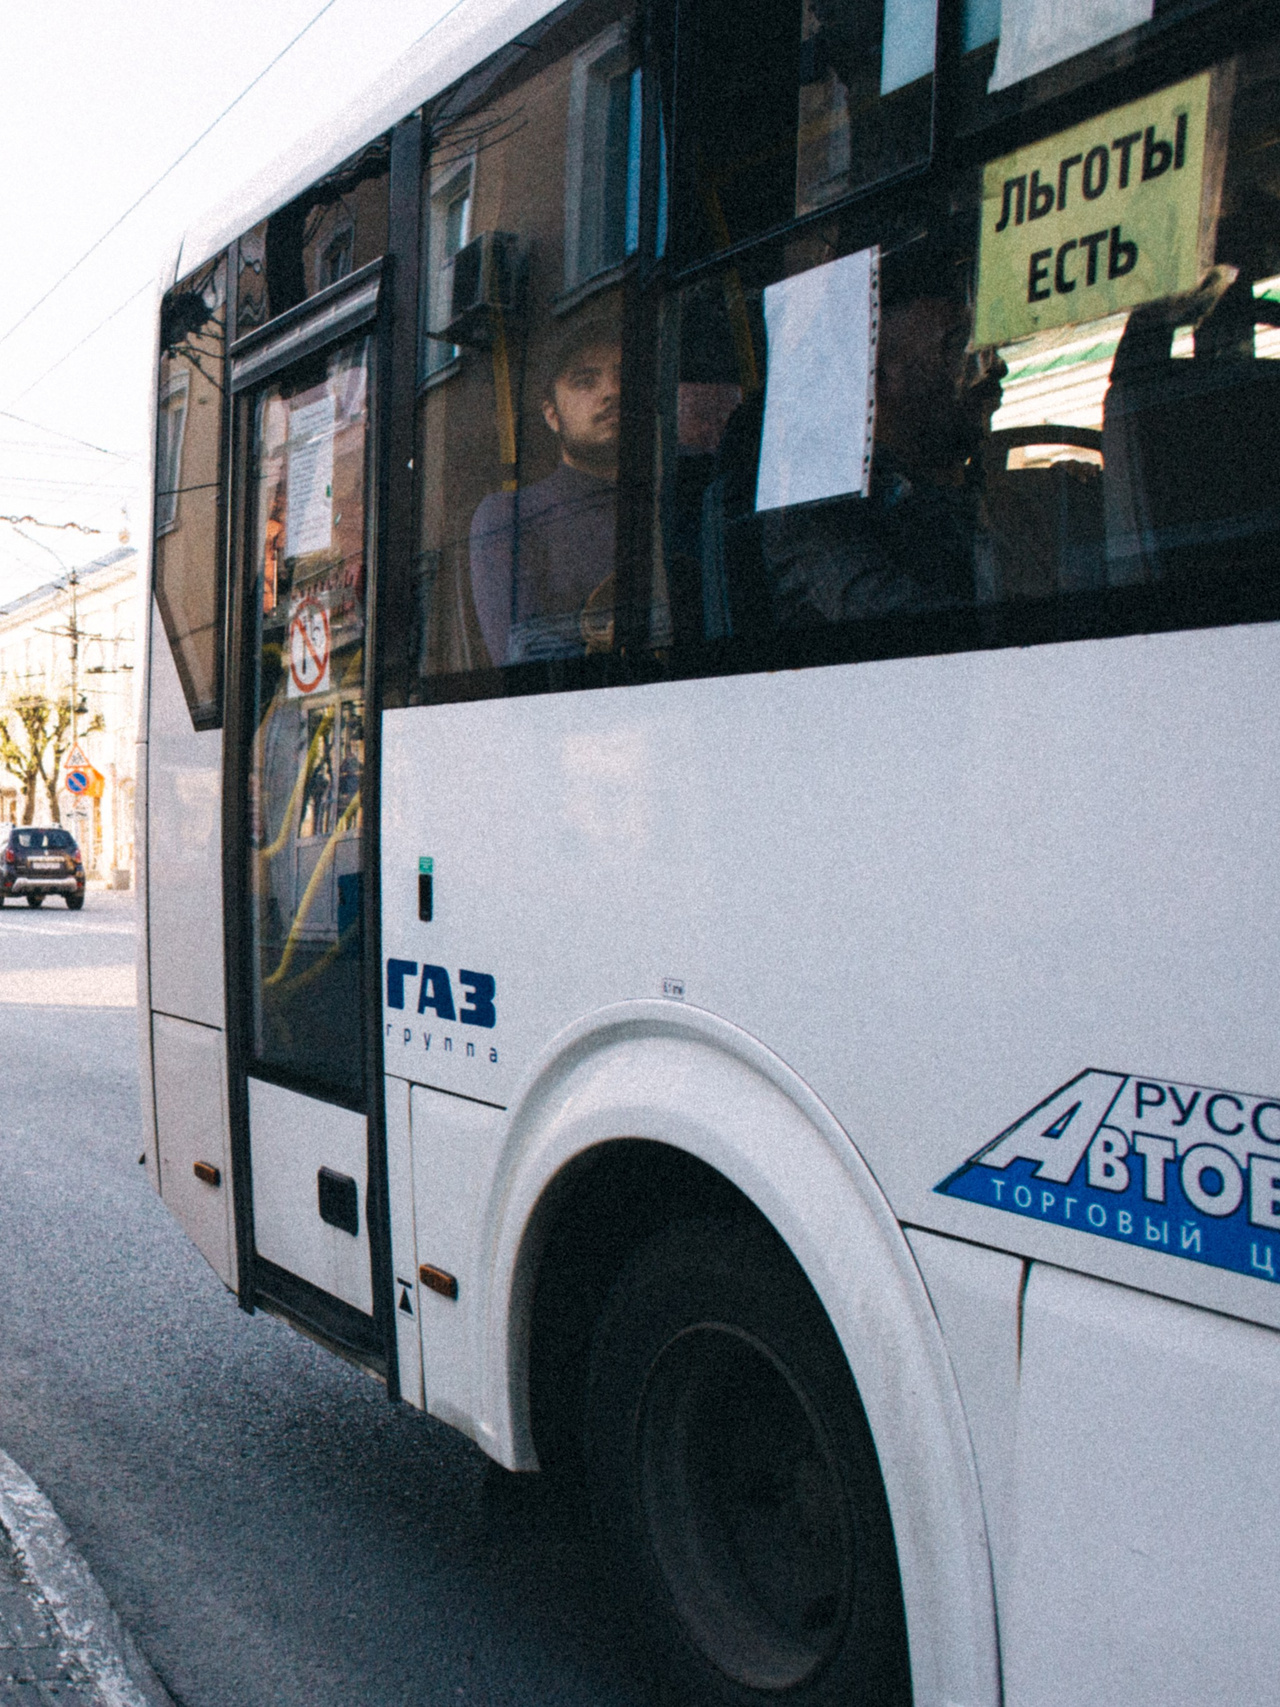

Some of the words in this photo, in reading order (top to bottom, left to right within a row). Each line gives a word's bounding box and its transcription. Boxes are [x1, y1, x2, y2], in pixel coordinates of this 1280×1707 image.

[995, 112, 1188, 233] ЛЬГОТЫ
[1028, 225, 1139, 303] ЕСТЬ
[386, 958, 497, 1029] ГАЗ
[386, 1023, 498, 1063] группа
[991, 1179, 1201, 1253] ТОРГОВЫЙ
